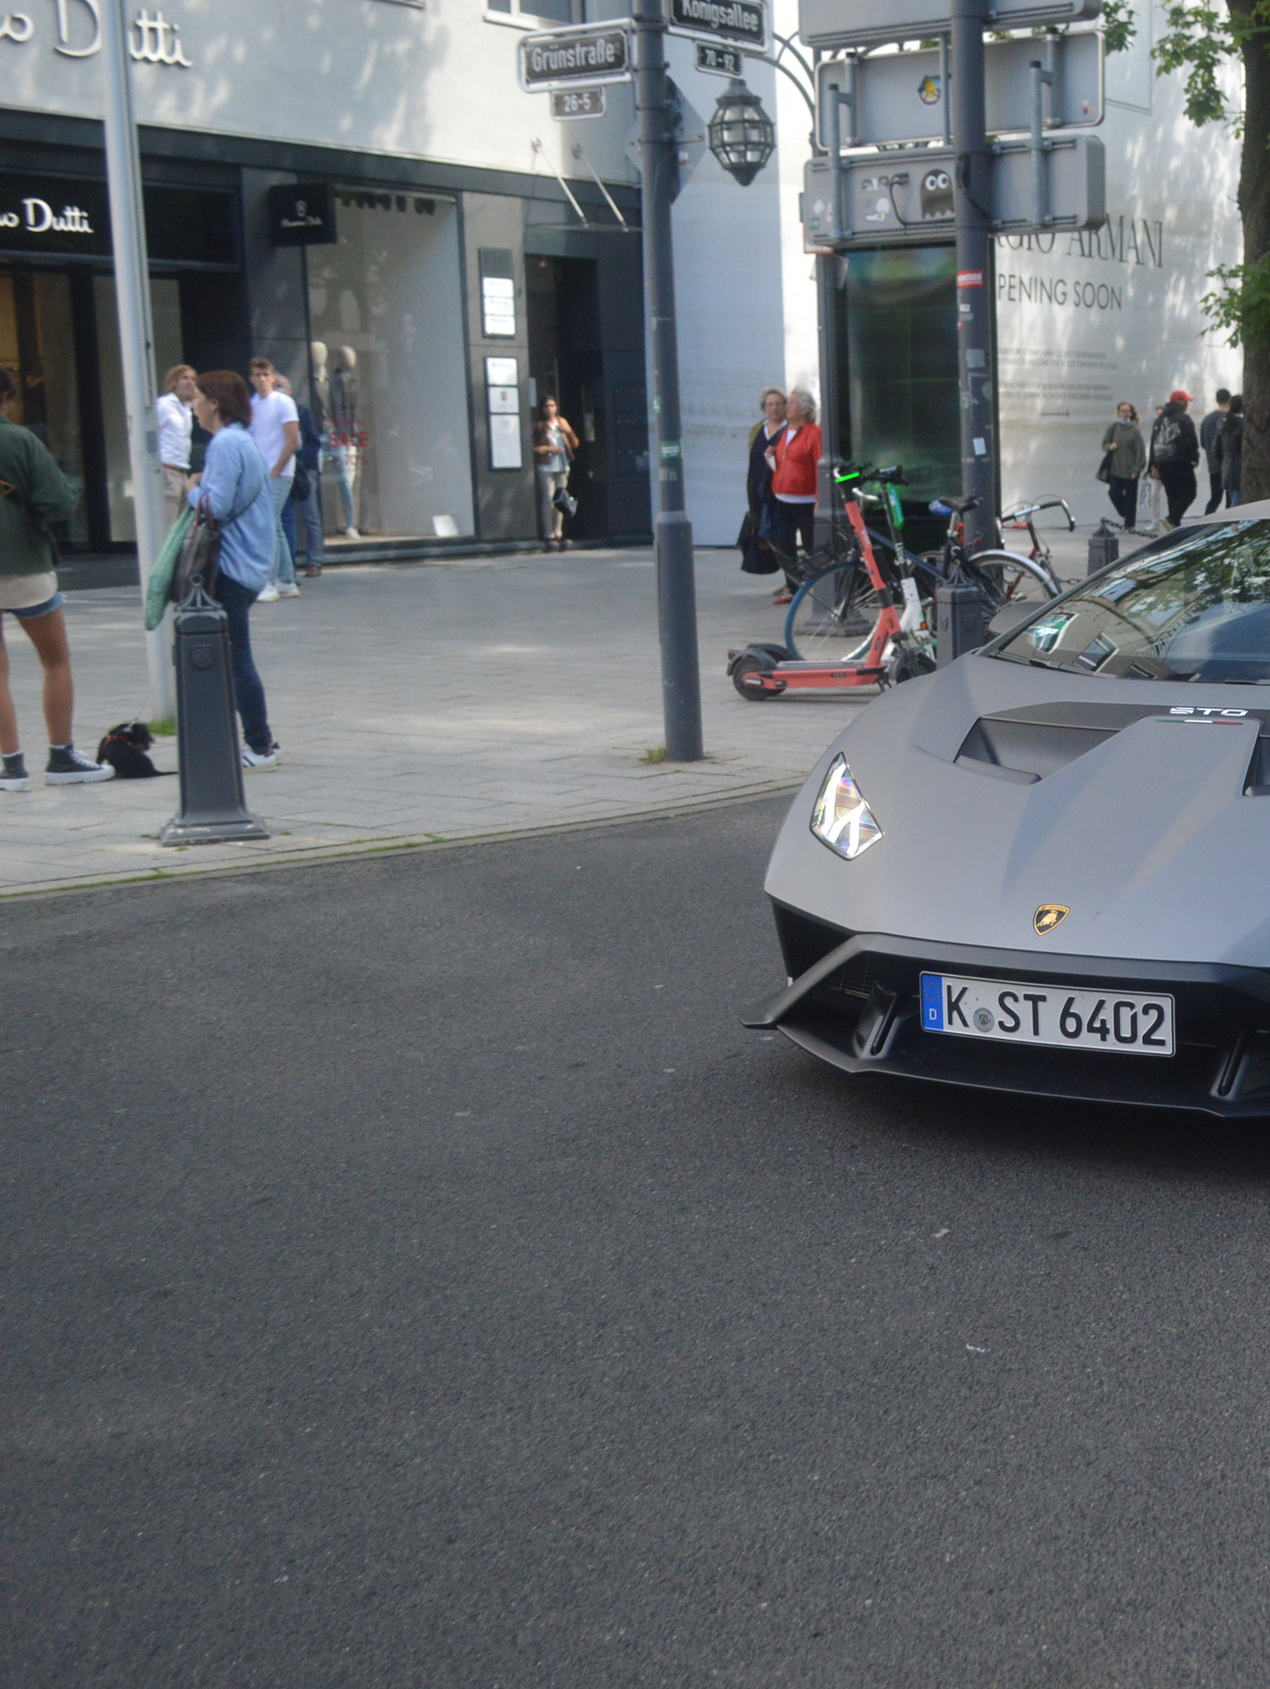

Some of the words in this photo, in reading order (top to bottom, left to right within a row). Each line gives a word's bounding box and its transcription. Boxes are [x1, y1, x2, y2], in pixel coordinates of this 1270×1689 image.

[682, 0, 759, 32] Königsallee
[532, 39, 616, 72] Grünstraße
[22, 198, 94, 233] Dutti
[999, 273, 1067, 306] PENING
[1074, 281, 1123, 311] SOON
[1170, 706, 1249, 717] STO
[929, 1008, 938, 1021] D
[946, 984, 970, 1028] K
[998, 991, 1048, 1036] ST
[1059, 996, 1167, 1047] 6402
